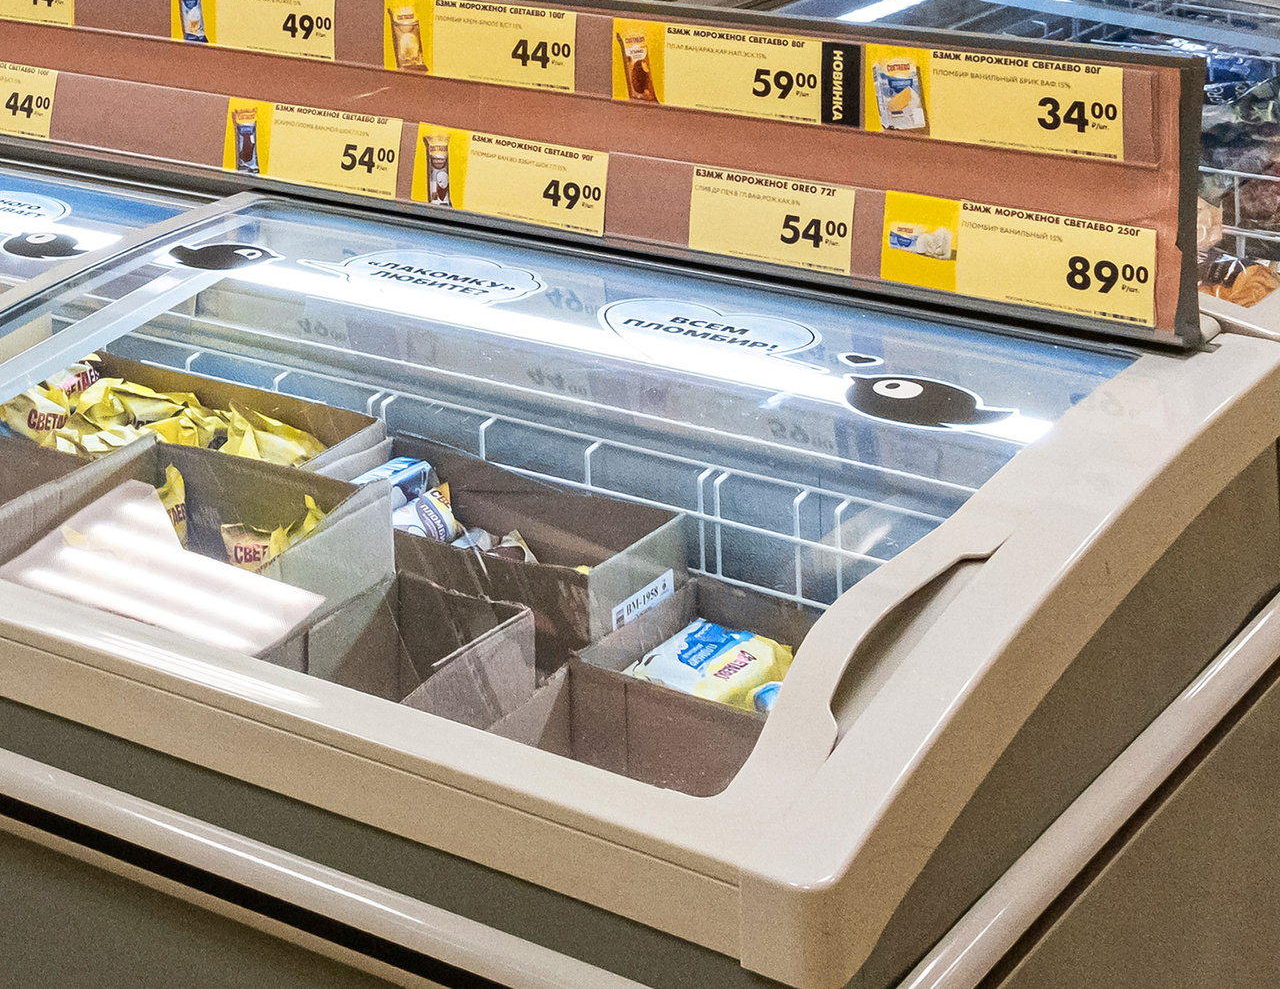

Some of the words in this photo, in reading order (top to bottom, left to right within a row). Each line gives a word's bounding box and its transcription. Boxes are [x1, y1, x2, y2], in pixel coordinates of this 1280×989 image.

[435, 0, 457, 8] БЗМЖ
[459, 2, 507, 13] МОРОЖЕНОЕ
[509, 7, 545, 17] СВЕТАЕВО
[549, 11, 565, 19] 100Г
[667, 27, 690, 37] БЗМЖ
[693, 30, 746, 42] МОРОЖЕНОЕ
[749, 36, 788, 47] СВЕТАЕВО
[791, 40, 805, 48] 80Г
[9, 63, 35, 73] СВЕТАЕВО
[933, 51, 961, 62] БЗМЖ
[965, 54, 1028, 68] МОРОЖЕНОЕ
[1032, 61, 1081, 73] СВЕТАЕВО
[1085, 66, 1101, 74] 80Г
[832, 49, 843, 121] НОВИНКА
[933, 69, 969, 79] ПЛОМБИР
[970, 71, 1018, 83] ВАНИЛЬНЫЙ
[275, 104, 295, 113] БЗМЖ
[297, 107, 339, 119] МОРОЖЕНОЕ
[342, 114, 375, 124] СВЕТАЕВО
[472, 134, 493, 144] БЗМЖ
[495, 138, 542, 153] МОРОЖЕНОЕ
[544, 147, 579, 159] СВЕТАЕВО
[696, 169, 723, 180] БЗМЖ
[726, 172, 788, 190] МОРОЖЕНОЕ
[791, 183, 817, 193] OREO
[820, 187, 837, 196] 72Г
[961, 221, 999, 232] ПЛОМБИР
[1000, 225, 1048, 240] ВАНИЛЬНЫЙ
[962, 203, 991, 214] БЗМЖ
[994, 207, 1060, 224] МОРОЖЕНОЕ
[1063, 217, 1114, 233] СВЕТАЕВО
[1118, 226, 1140, 237] 250Г
[367, 260, 515, 292] «ЛАКОМКУ»
[371, 270, 489, 295] ЛЮБИТЕ?
[622, 318, 778, 352] ПЛОМБИР!
[669, 316, 749, 335] ВСЕМ
